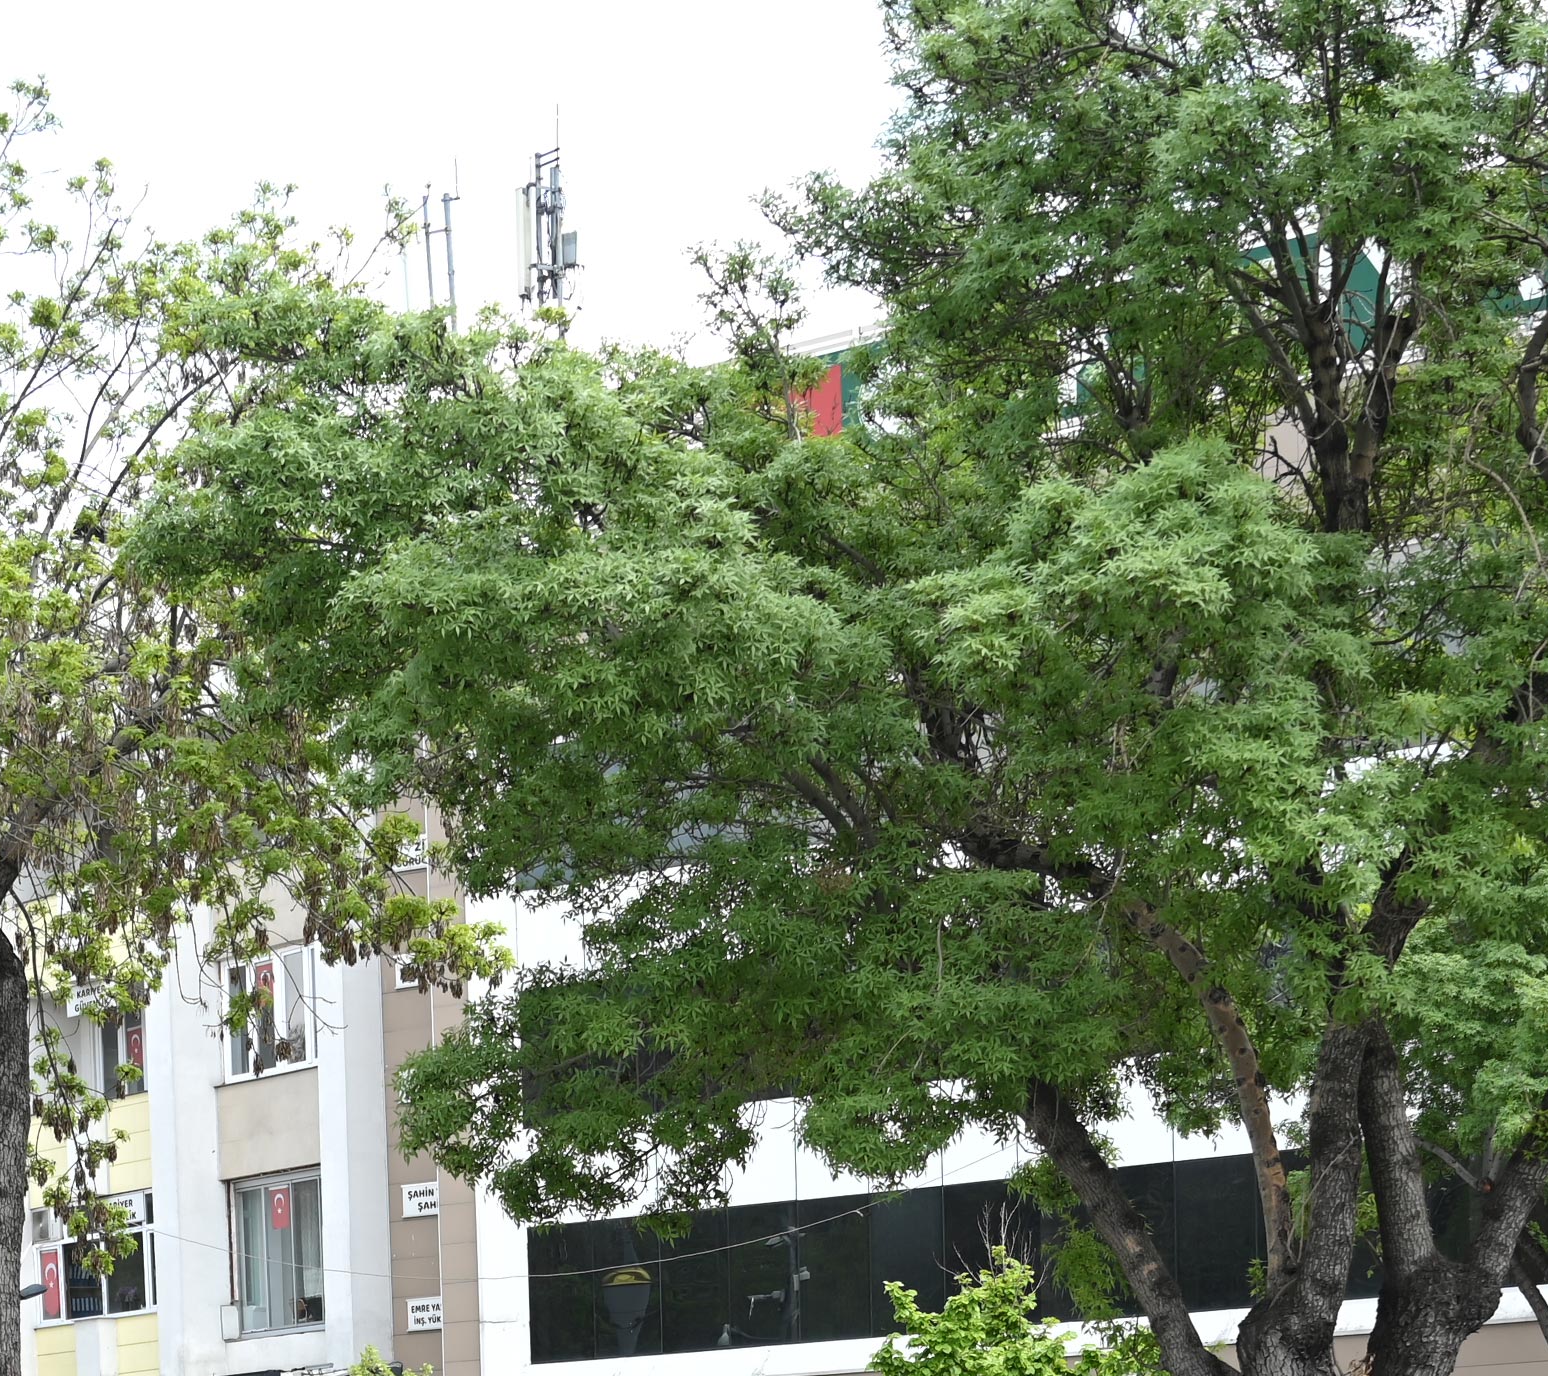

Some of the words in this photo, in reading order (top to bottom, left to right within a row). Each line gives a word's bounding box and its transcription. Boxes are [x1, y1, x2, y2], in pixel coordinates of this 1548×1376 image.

[407, 1186, 435, 1200] ŞAHİN
[411, 1303, 430, 1314] EMRE
[413, 1316, 426, 1326] İNŞ.
